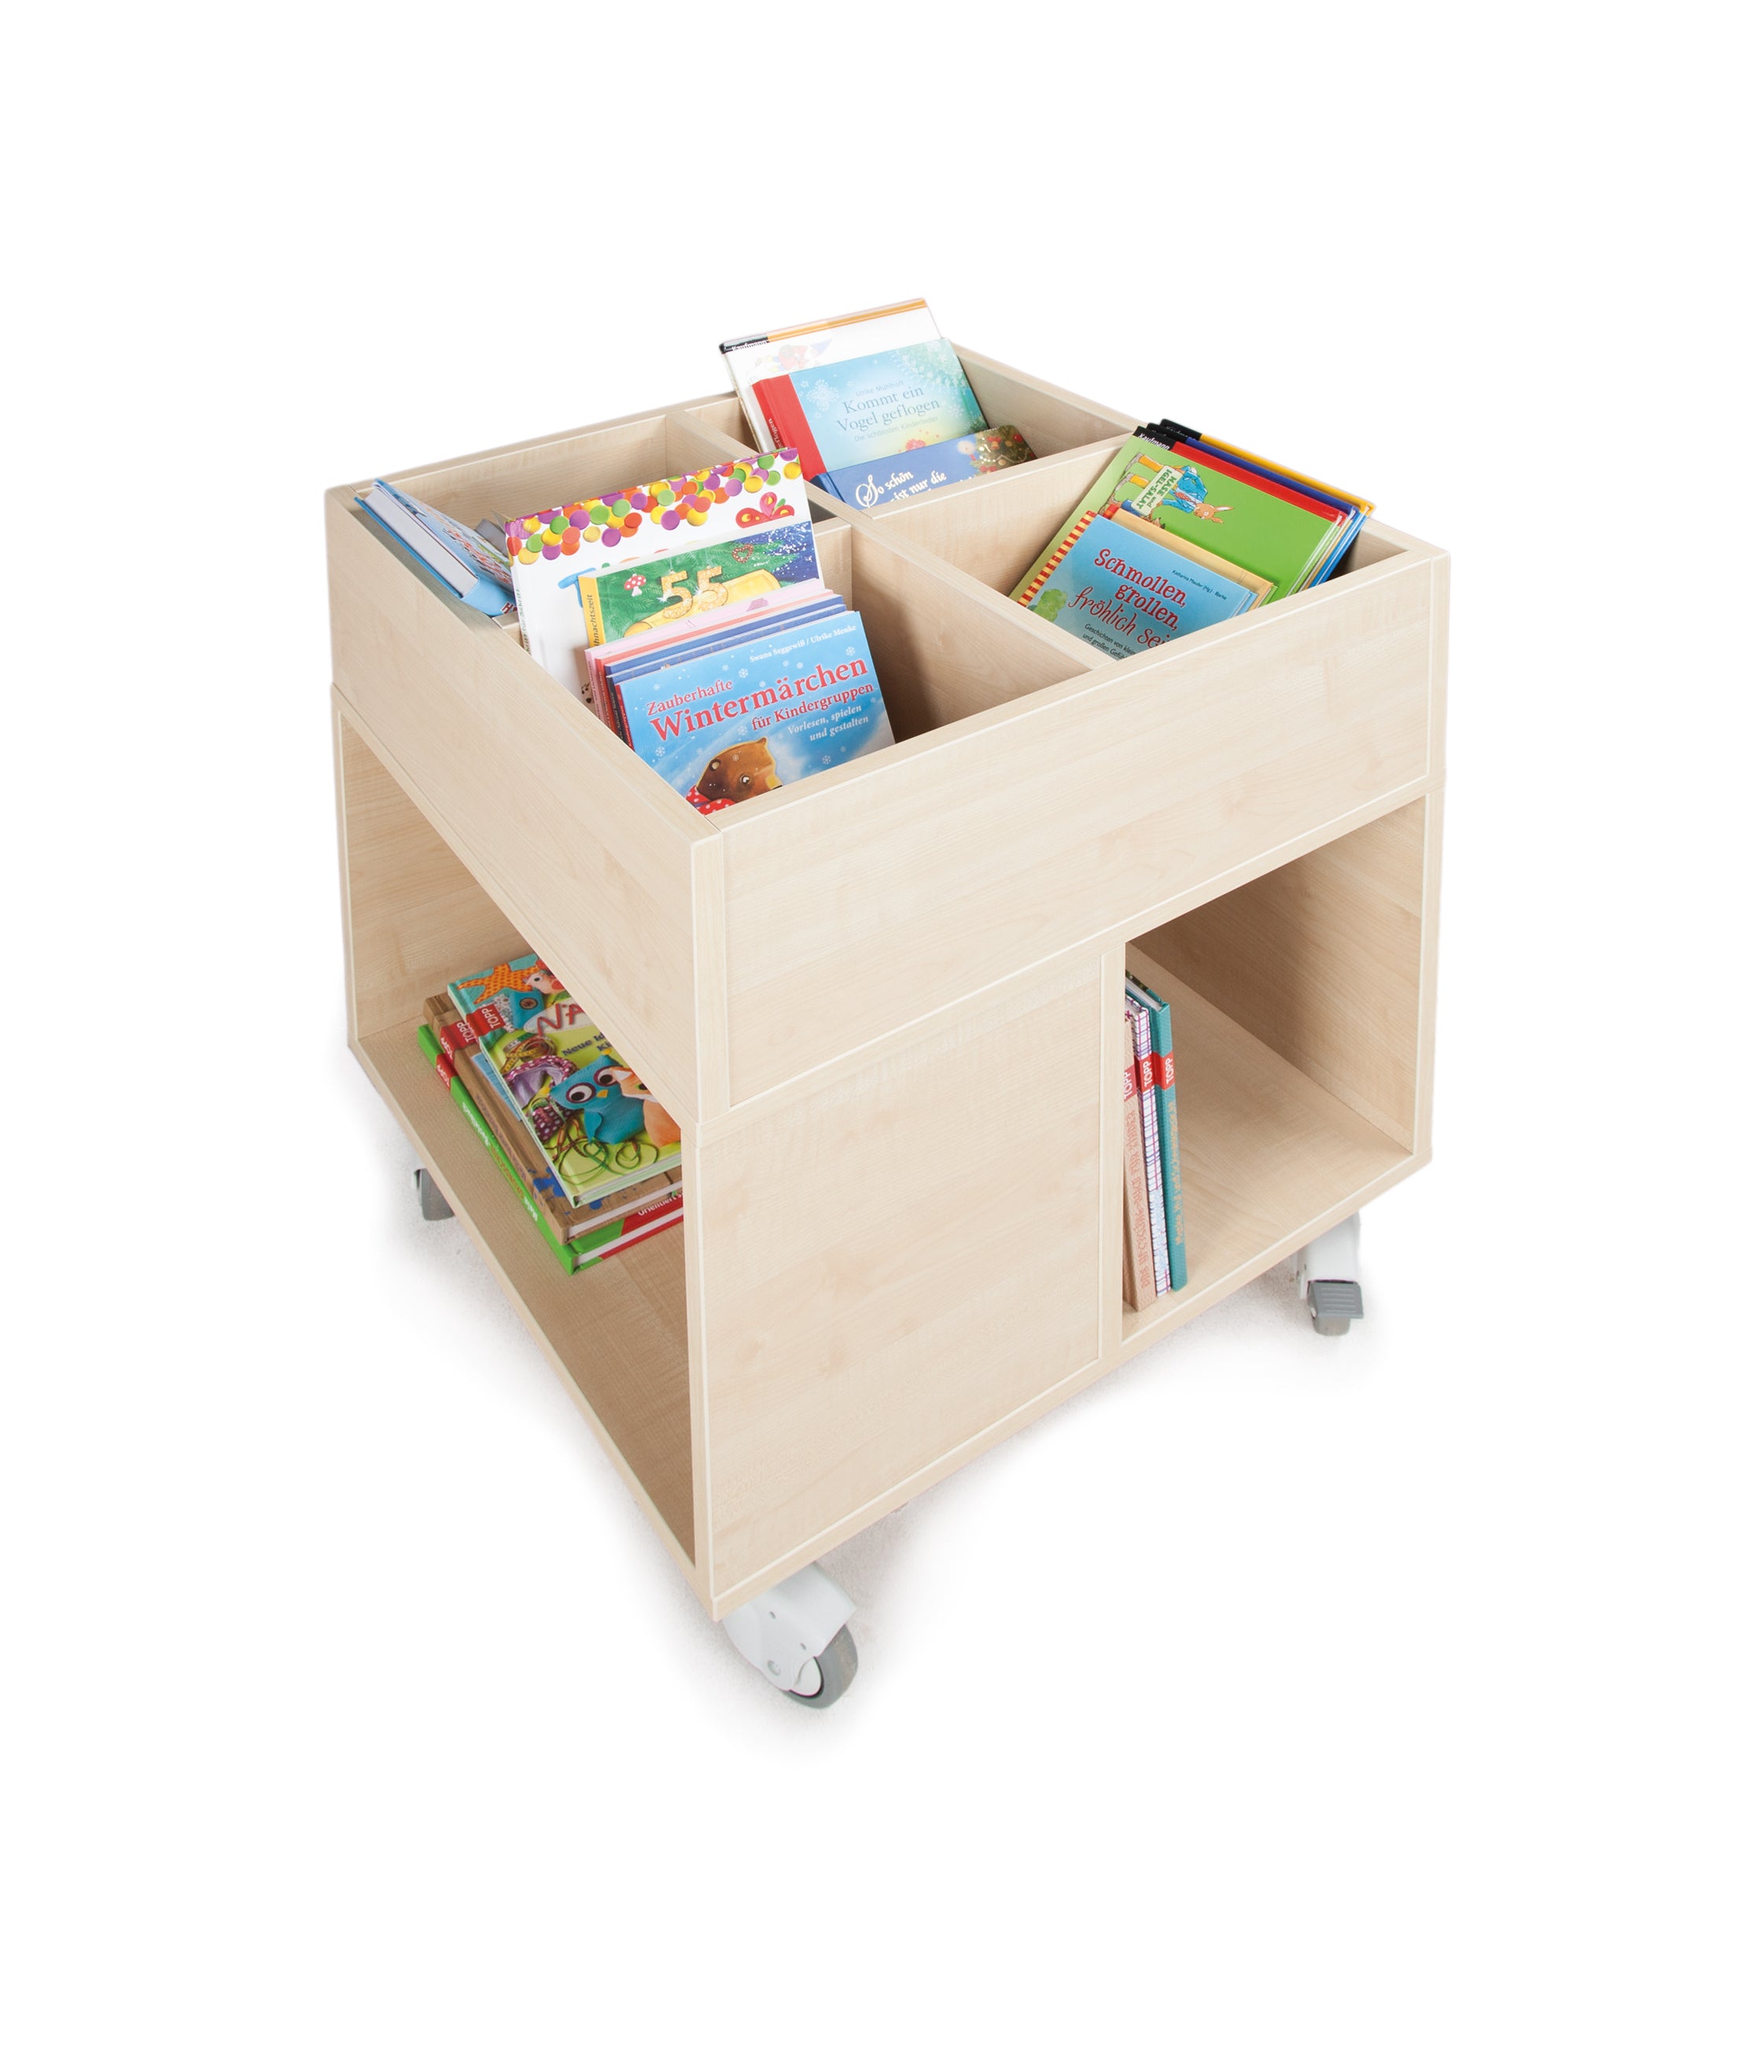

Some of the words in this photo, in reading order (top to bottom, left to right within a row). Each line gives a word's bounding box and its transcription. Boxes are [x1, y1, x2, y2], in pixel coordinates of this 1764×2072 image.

[843, 393, 898, 414] Kommt
[903, 385, 924, 400] ein
[837, 411, 878, 432] Vogel
[882, 399, 941, 426] geflogen
[867, 426, 900, 440] schönsten
[900, 416, 938, 430] Kinderlieder
[1138, 433, 1170, 451] Kaufmann
[885, 470, 914, 491] schön
[909, 478, 928, 494] nur
[930, 470, 947, 485] die
[1136, 469, 1173, 510] IGEL-SALAT
[1157, 475, 1177, 496] HASE
[1146, 496, 1157, 508] und
[1094, 548, 1187, 608] Schmollen,
[661, 566, 728, 619] 55
[1068, 586, 1137, 636] fröhlich
[1114, 584, 1180, 632] grollen,
[749, 652, 772, 662] Swana
[773, 640, 805, 655] Seggewiß
[811, 632, 832, 643] Ulrike
[834, 625, 856, 636] Menke
[1085, 623, 1114, 643] Geschichten
[1091, 639, 1110, 652] großen
[646, 679, 734, 717] Zauberhafte
[650, 658, 868, 742] Wintermärchen
[751, 716, 772, 731] für
[775, 683, 874, 723] Kindergruppen
[787, 717, 829, 736] Vorlesen,
[830, 704, 863, 724] spielen
[809, 728, 828, 742] und
[829, 715, 869, 736] gestalten
[457, 1022, 476, 1042] TOPP
[481, 1008, 501, 1029] TOPP
[562, 1039, 592, 1056] Neue
[1143, 1061, 1153, 1087] TOPP
[1166, 1058, 1174, 1085] TOPP
[1124, 1071, 1132, 1100] TOPP
